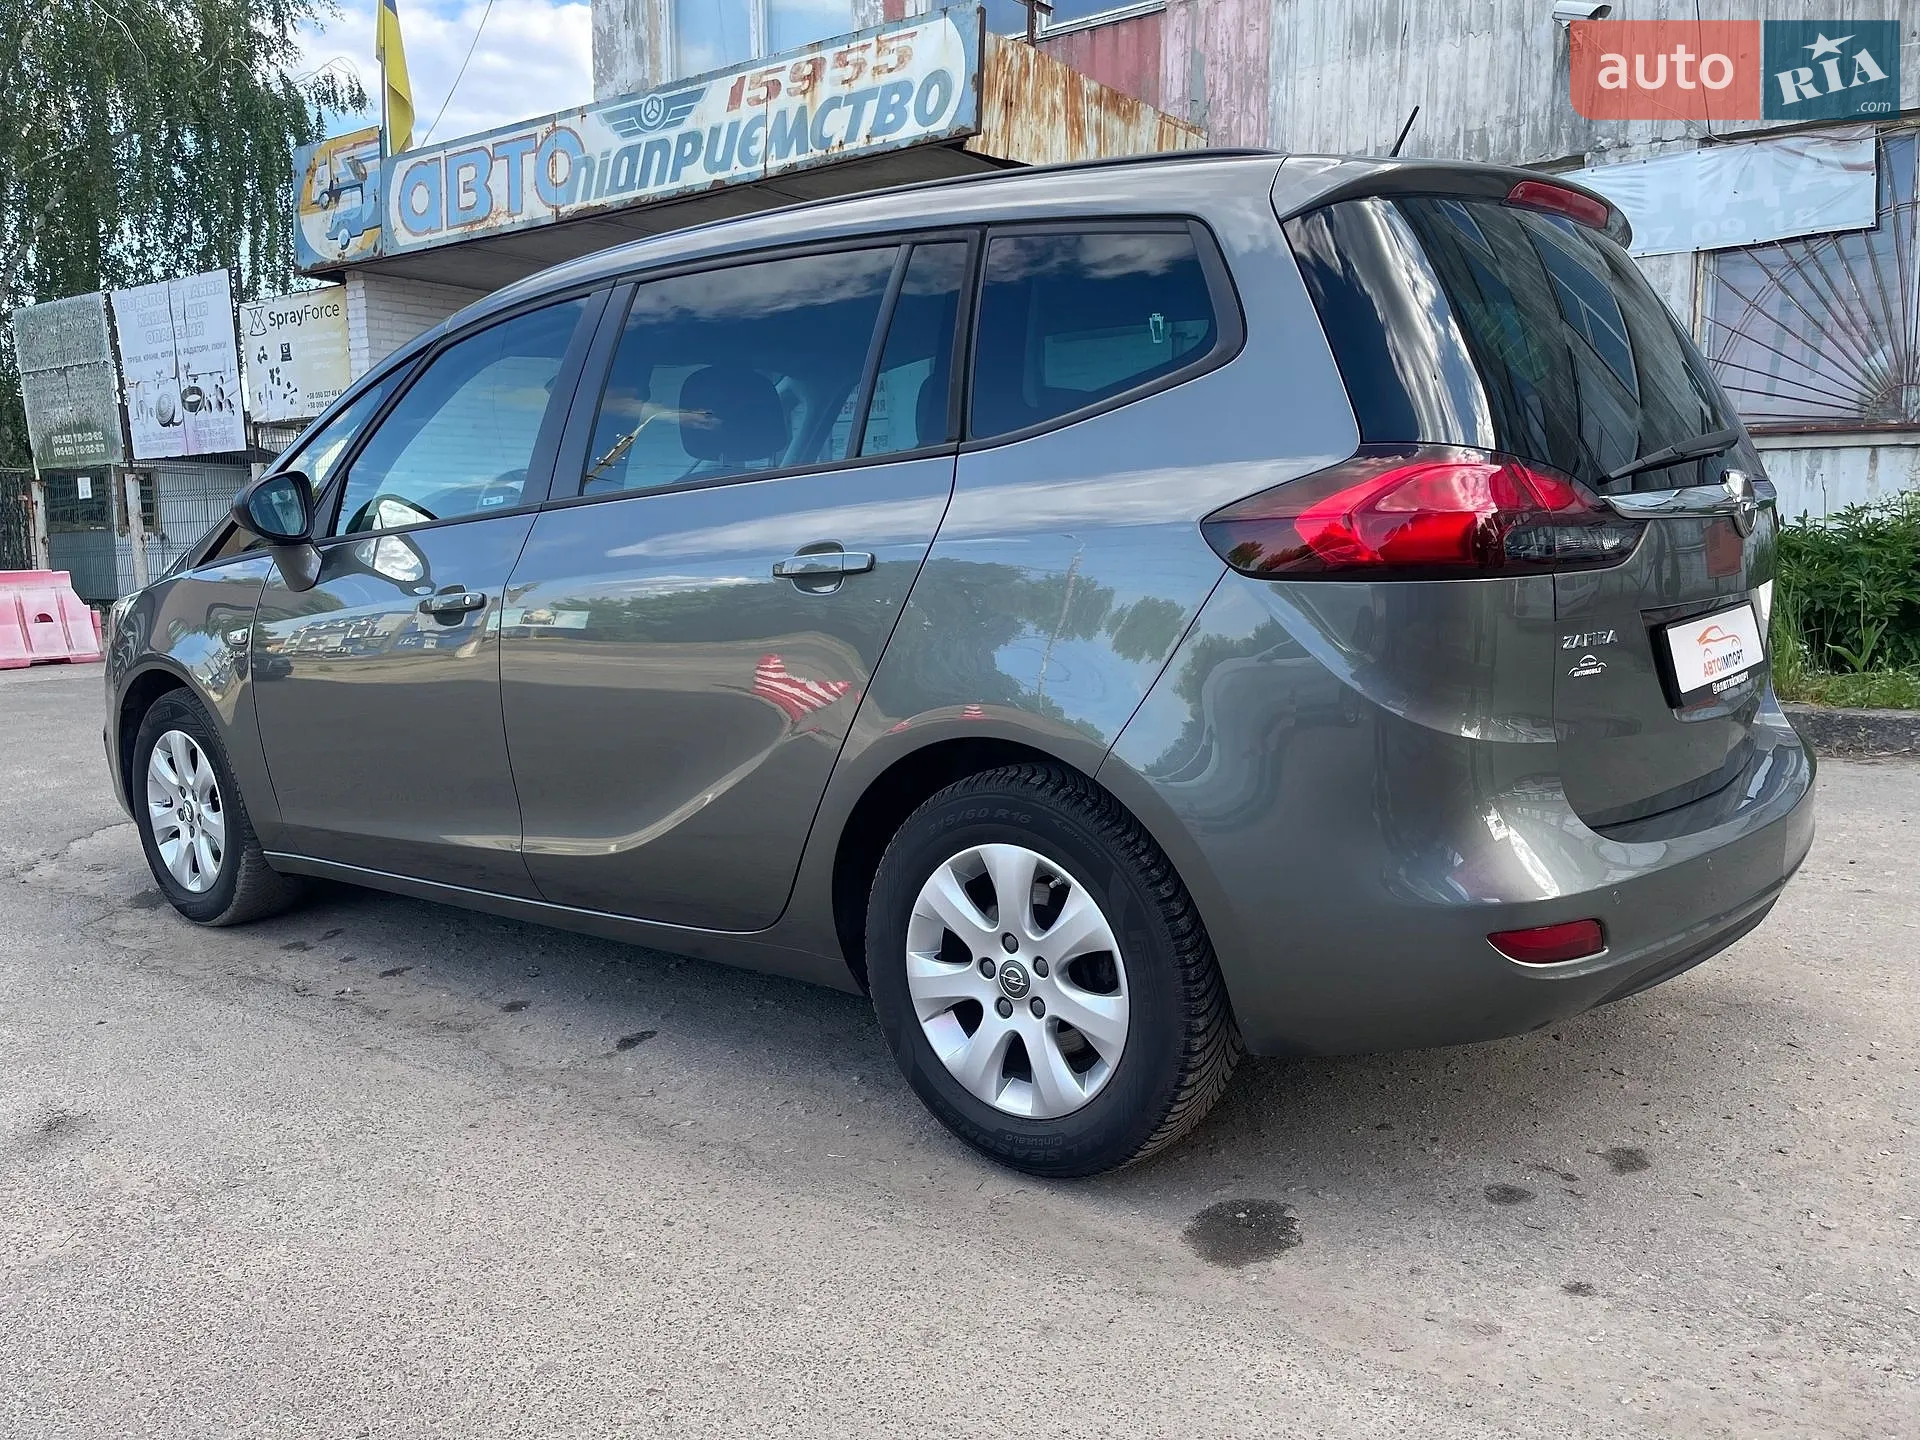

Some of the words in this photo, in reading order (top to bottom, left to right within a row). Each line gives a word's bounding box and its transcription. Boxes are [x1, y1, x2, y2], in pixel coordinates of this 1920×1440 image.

[727, 31, 917, 112] 15955
[268, 304, 340, 330] SprayForce
[1563, 630, 1618, 649] ZAFIRA
